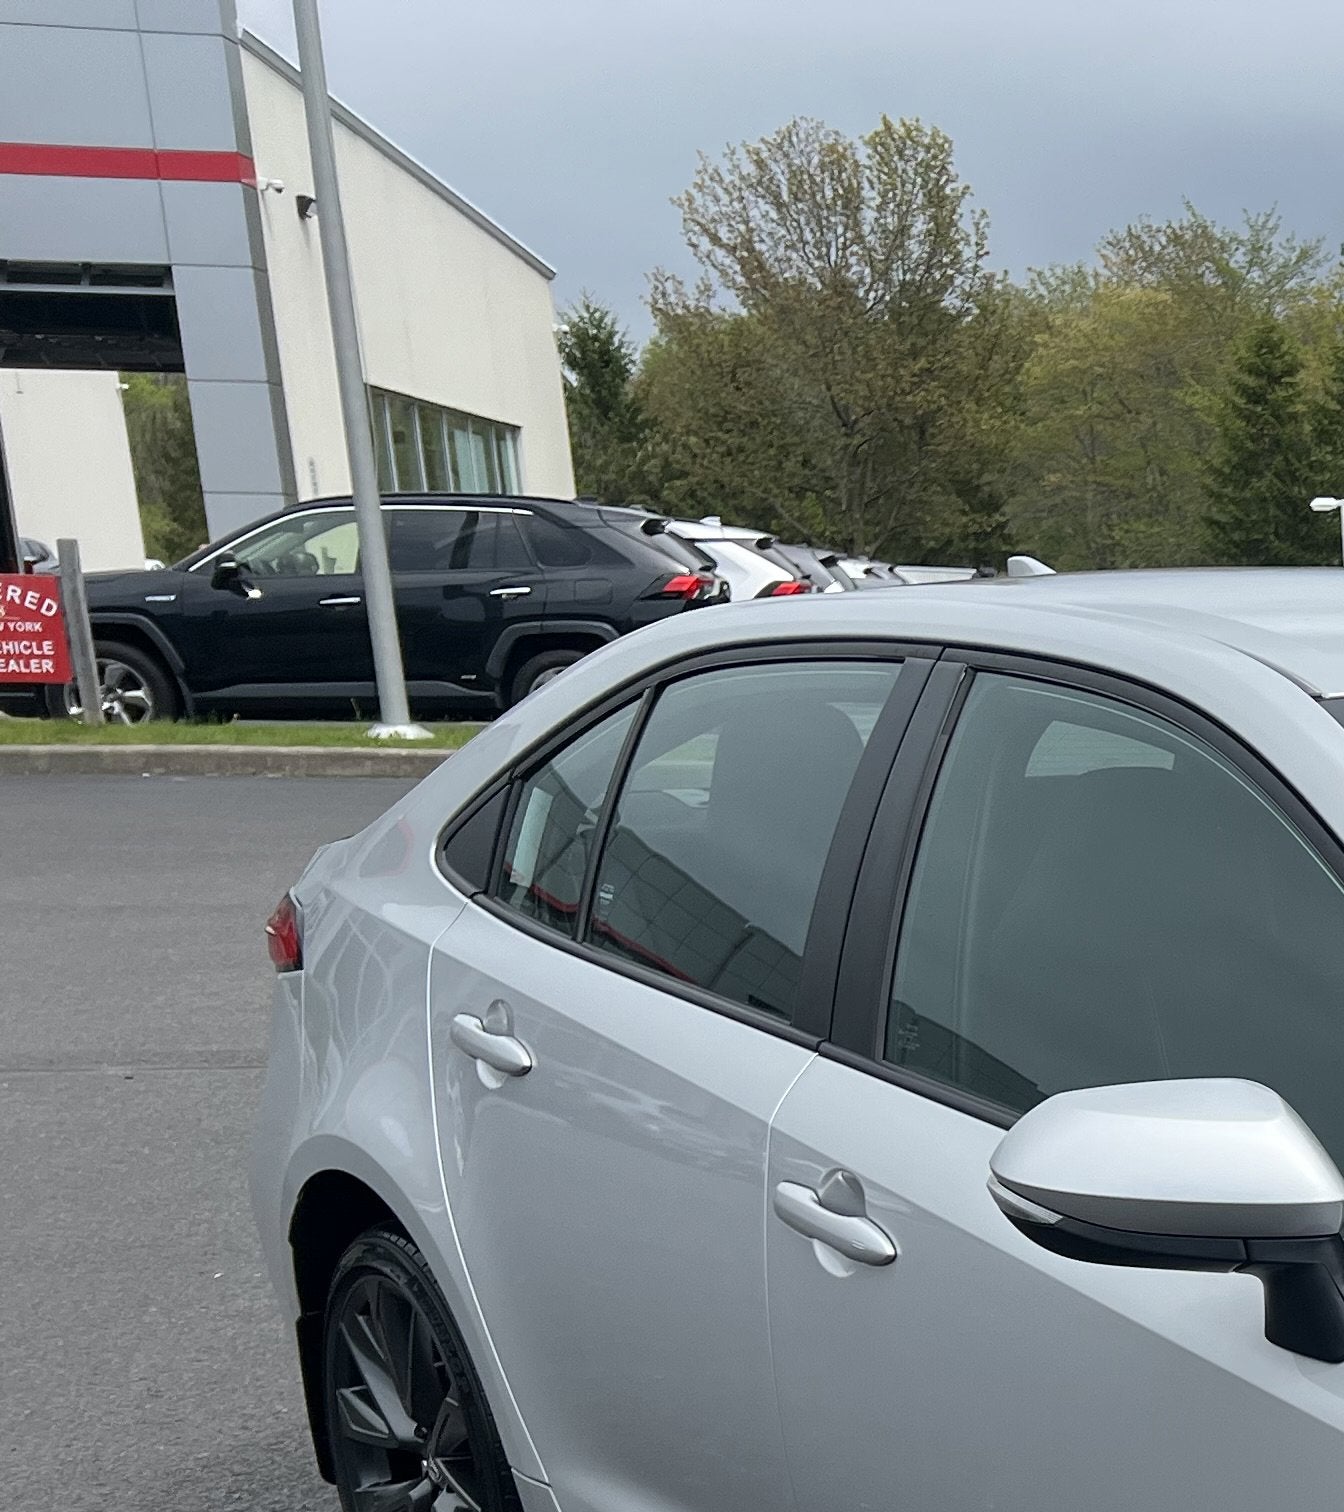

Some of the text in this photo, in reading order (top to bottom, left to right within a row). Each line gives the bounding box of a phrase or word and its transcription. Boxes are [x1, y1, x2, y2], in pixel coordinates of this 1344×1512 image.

[0, 582, 58, 617] RED
[7, 621, 43, 632] YORK
[0, 640, 55, 655] HICLE
